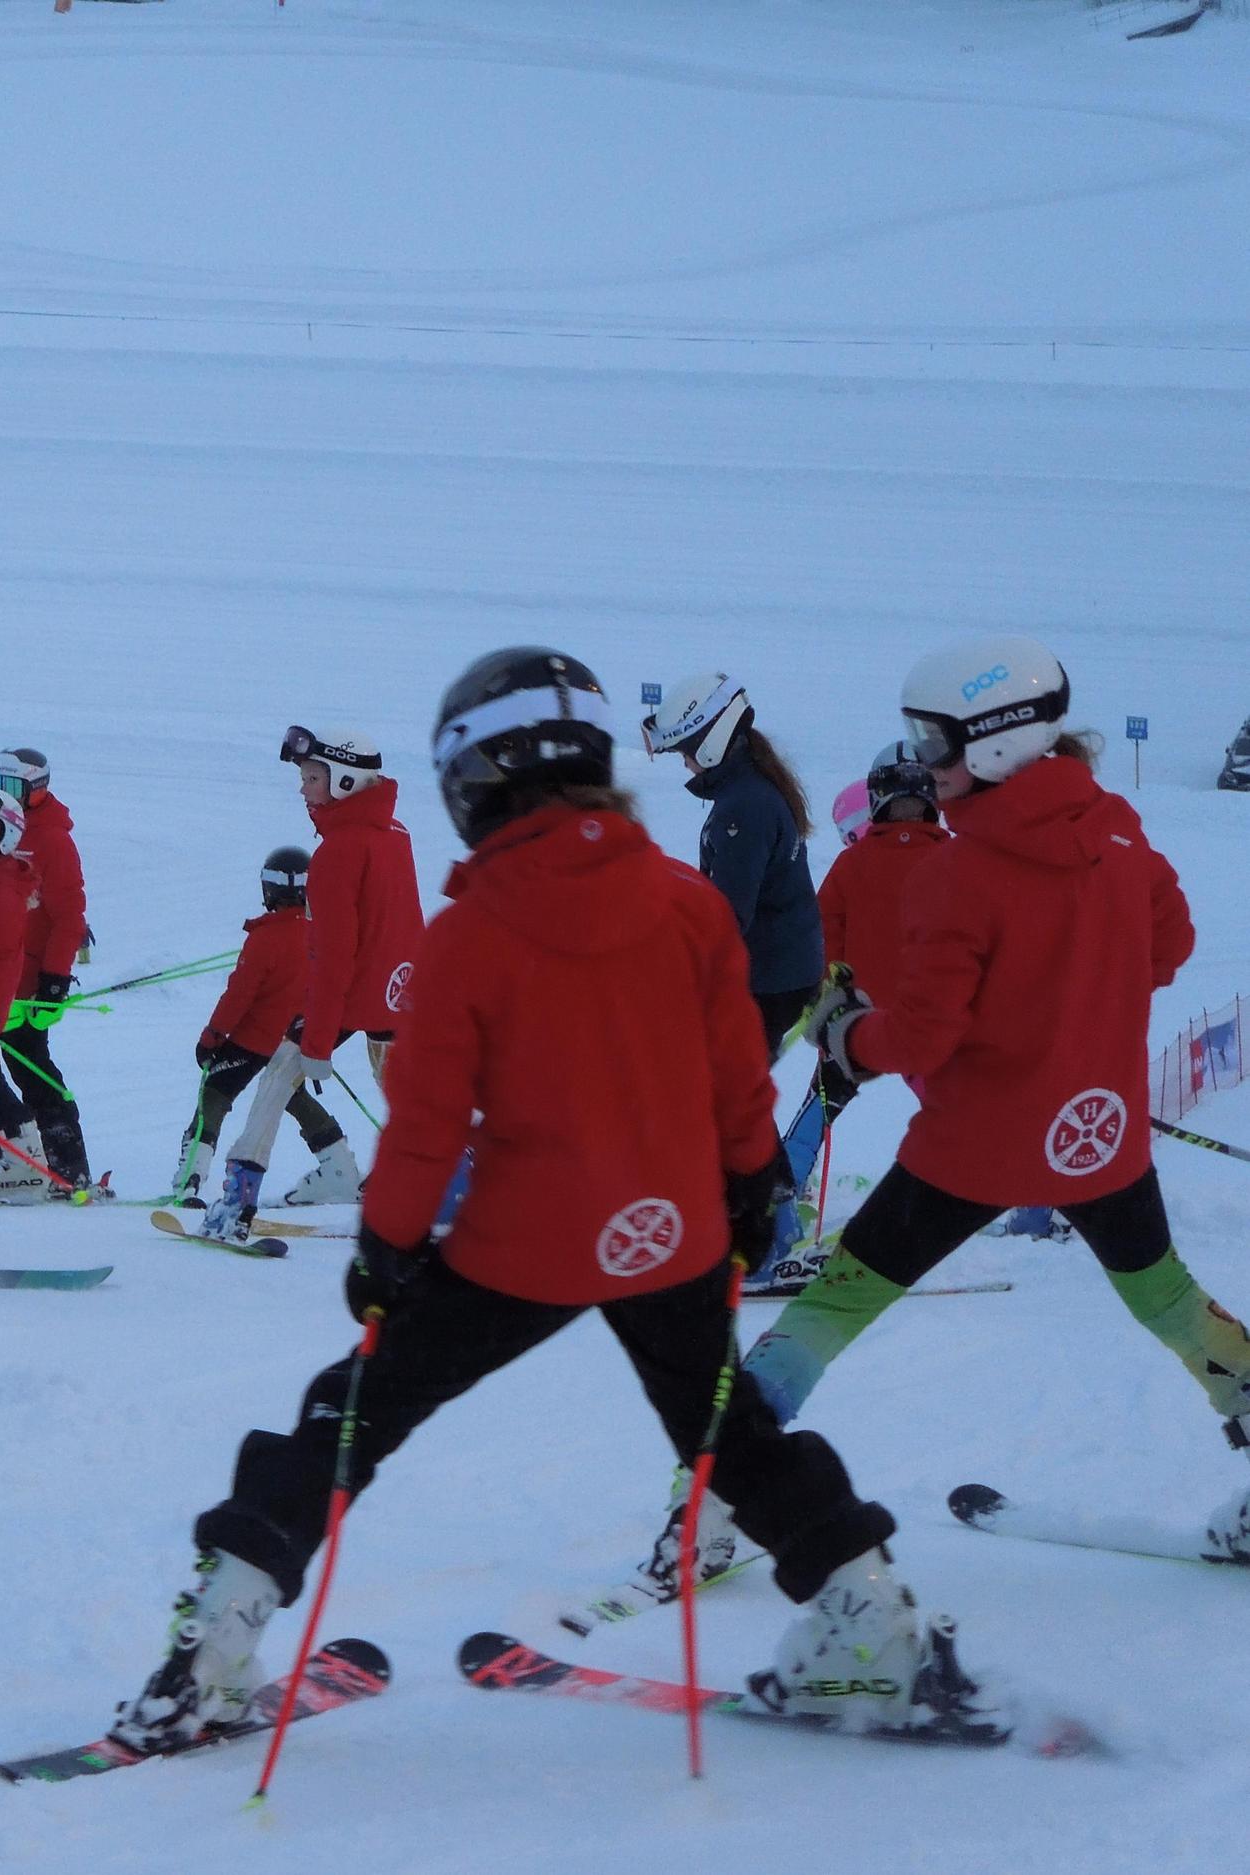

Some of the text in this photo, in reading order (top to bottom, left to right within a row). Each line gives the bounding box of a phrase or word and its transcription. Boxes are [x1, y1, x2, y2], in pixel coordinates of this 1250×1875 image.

[662, 714, 705, 740] HEAD
[966, 706, 1036, 736] HEAD
[1082, 1102, 1098, 1120] H
[1058, 1122, 1116, 1146] L S
